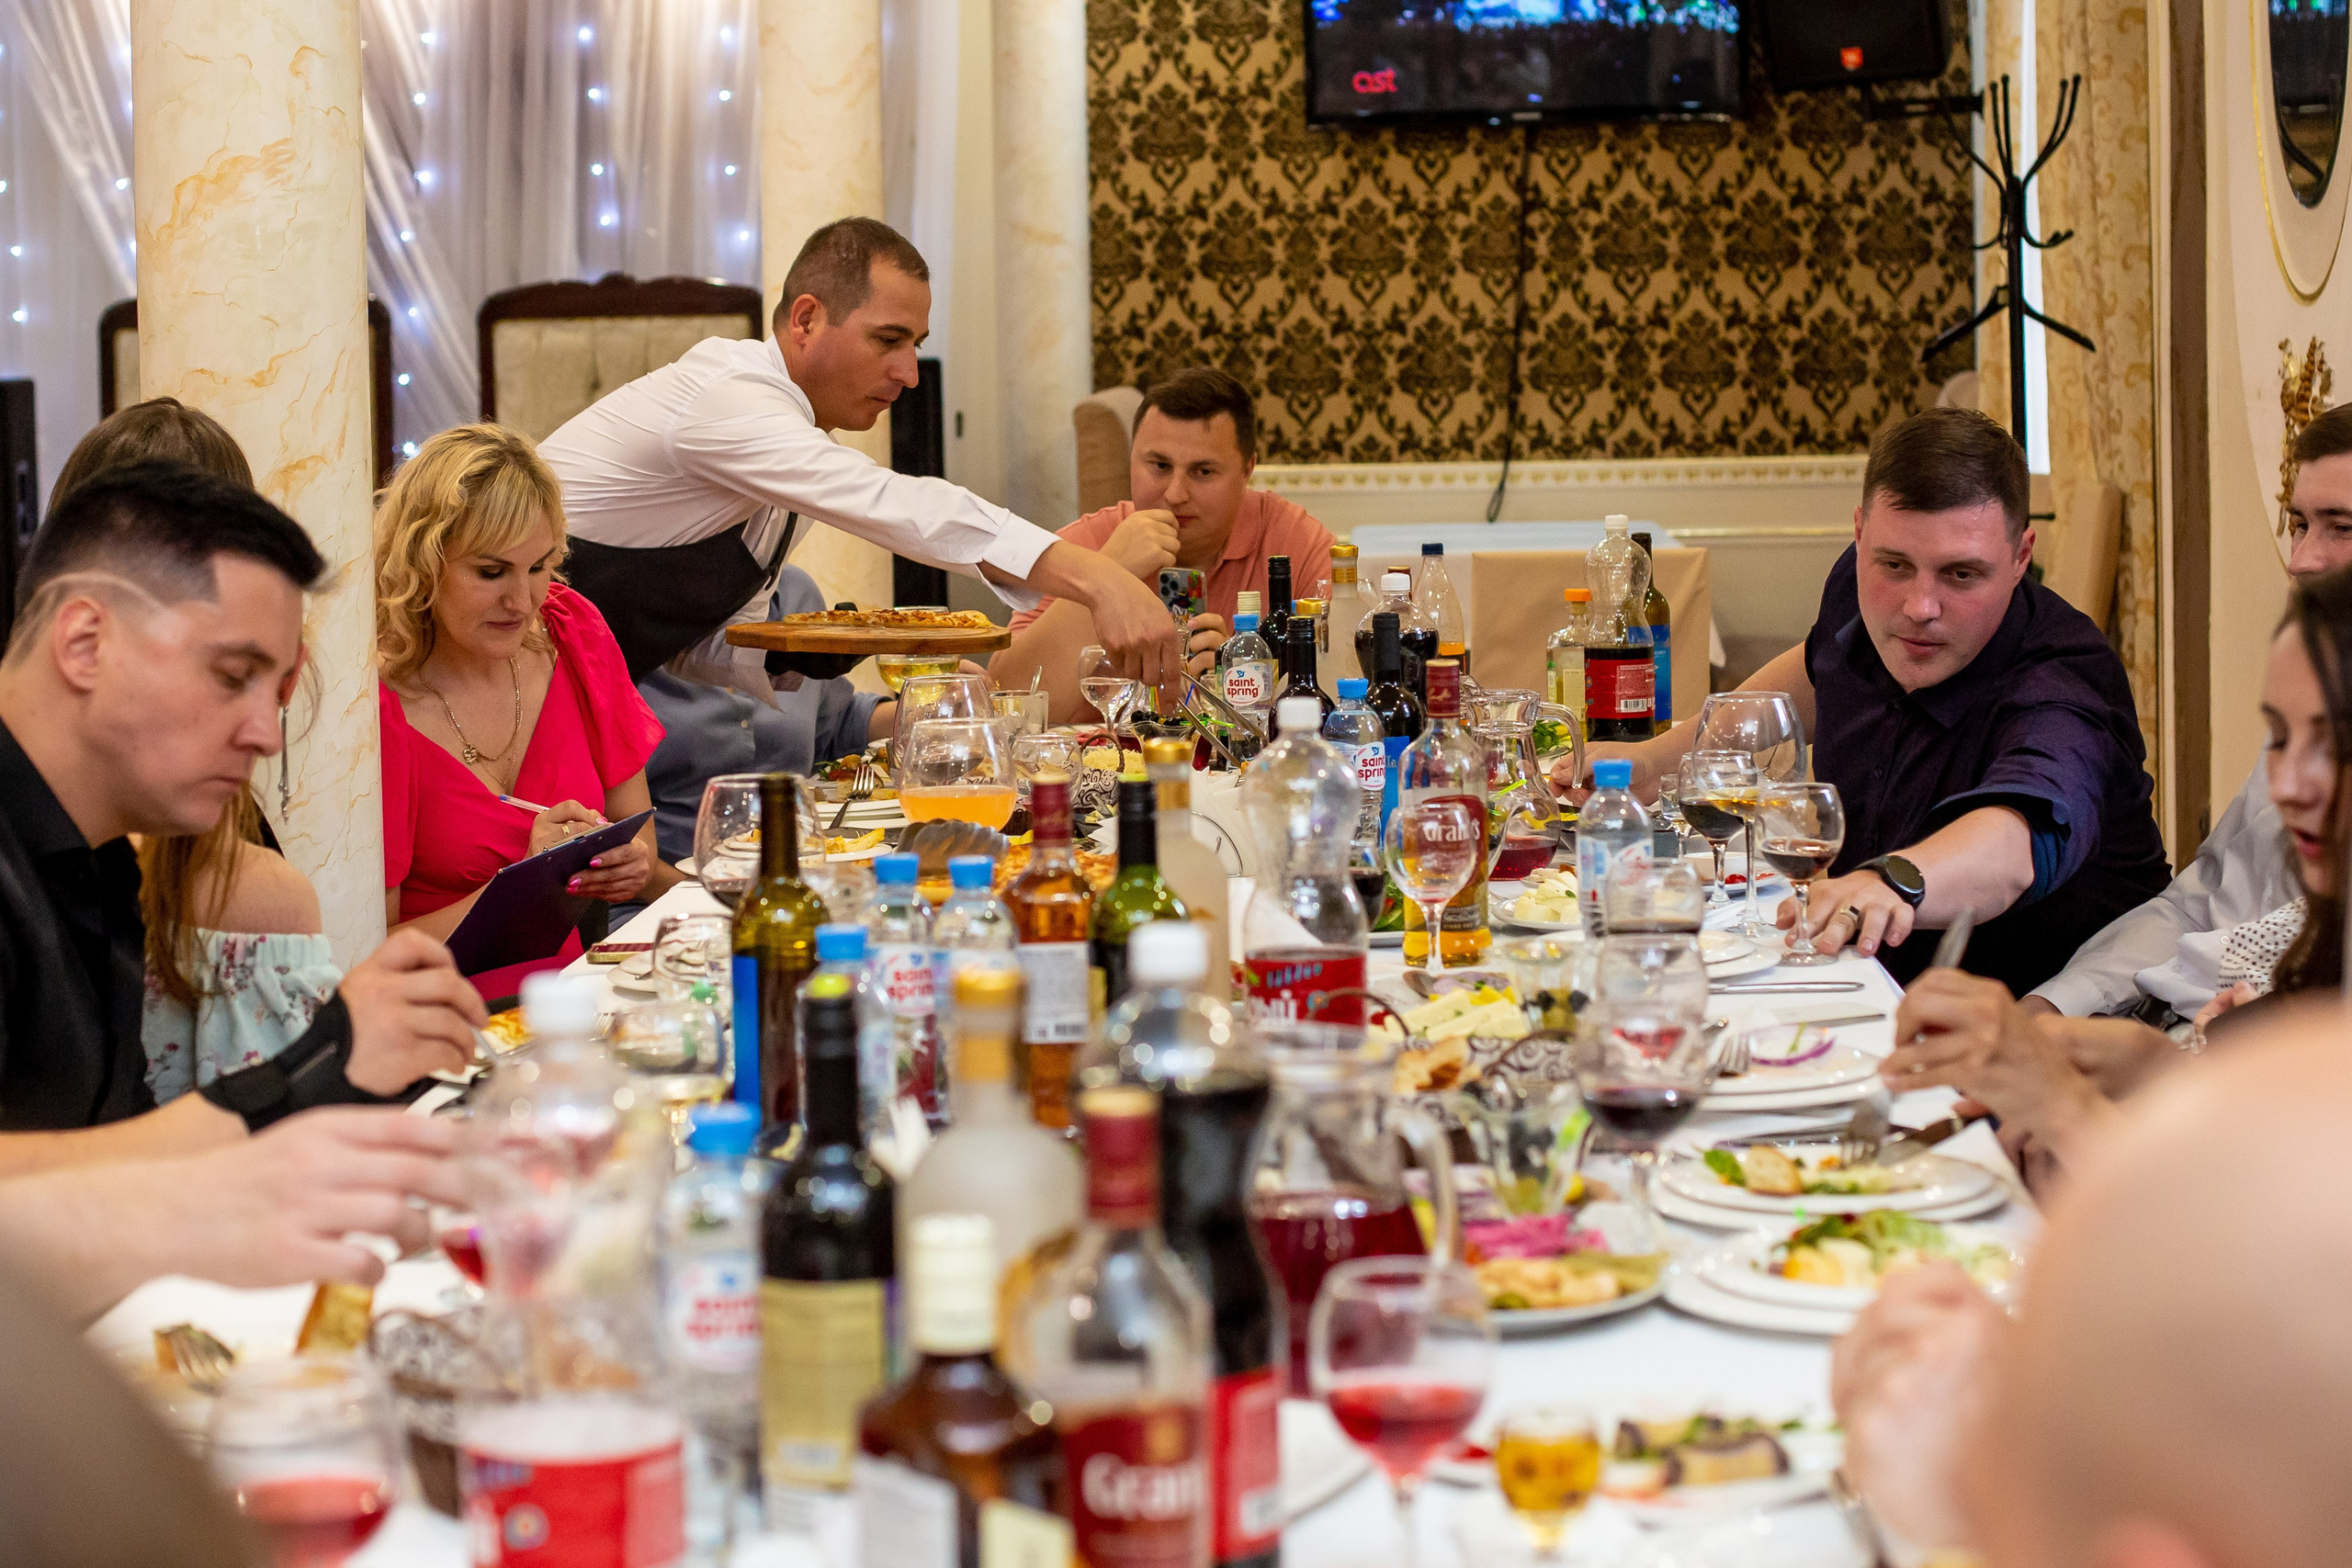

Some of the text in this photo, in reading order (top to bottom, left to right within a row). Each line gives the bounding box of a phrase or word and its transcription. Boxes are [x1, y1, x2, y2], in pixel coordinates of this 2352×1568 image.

[1228, 677, 1255, 687] saint
[1227, 687, 1259, 698] spring
[1357, 767, 1385, 781] sprin
[1421, 818, 1481, 842] Grans
[1080, 1452, 1206, 1521] Gran
